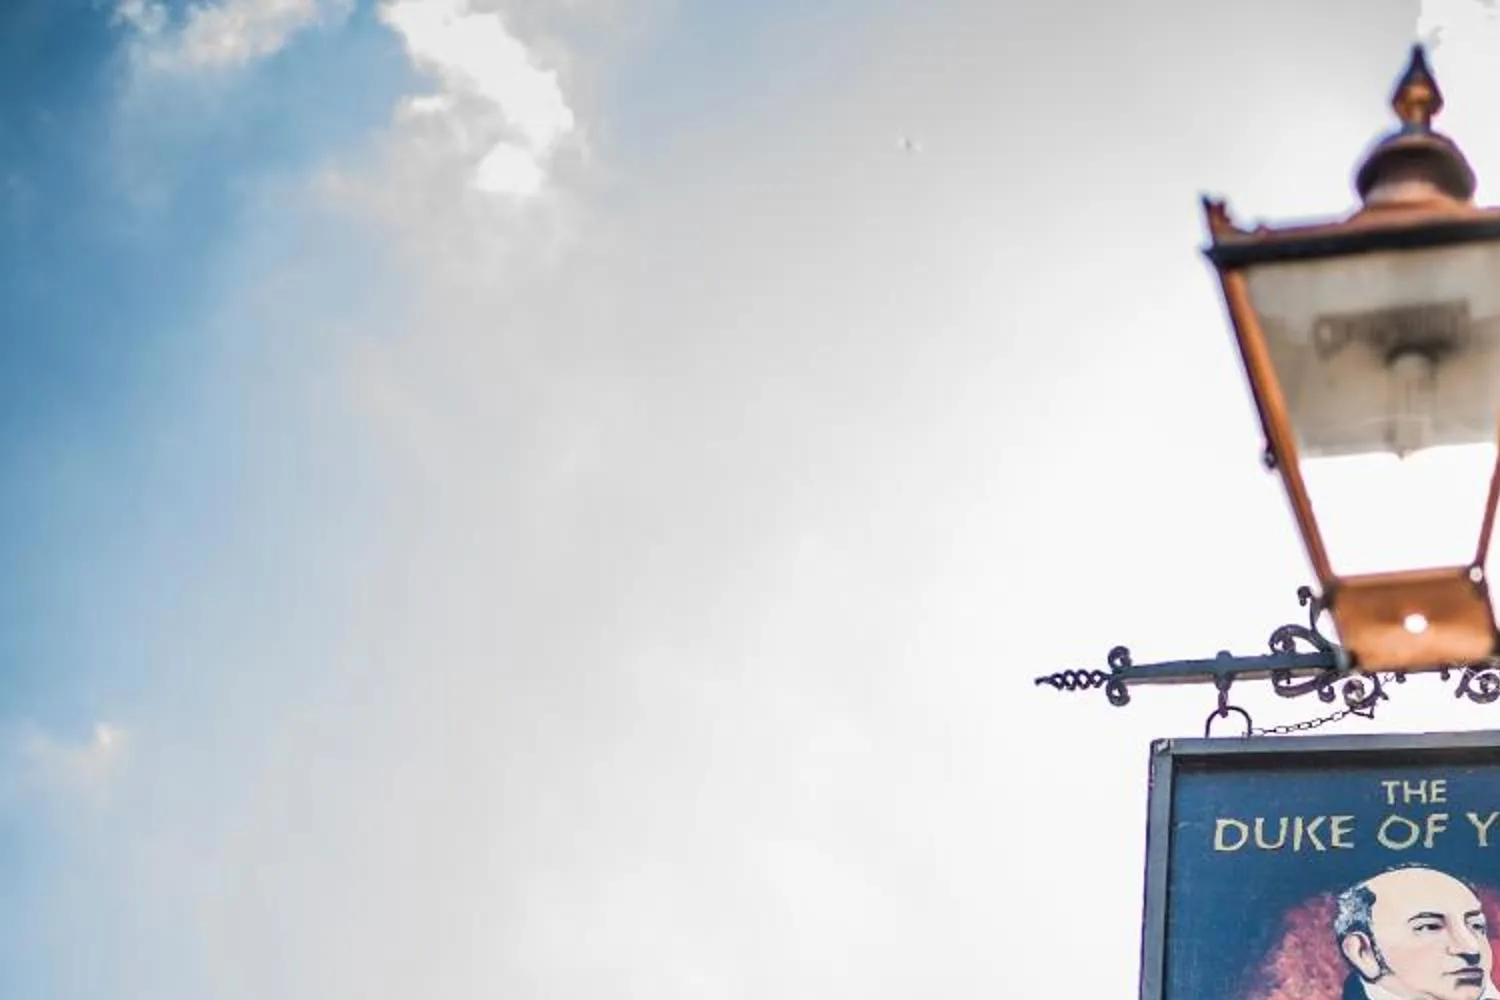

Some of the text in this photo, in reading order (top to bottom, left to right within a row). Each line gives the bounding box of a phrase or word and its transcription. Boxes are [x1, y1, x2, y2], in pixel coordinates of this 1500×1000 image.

[1381, 780, 1447, 804] THE
[1214, 815, 1355, 852] DUKE
[1377, 813, 1449, 850] OF
